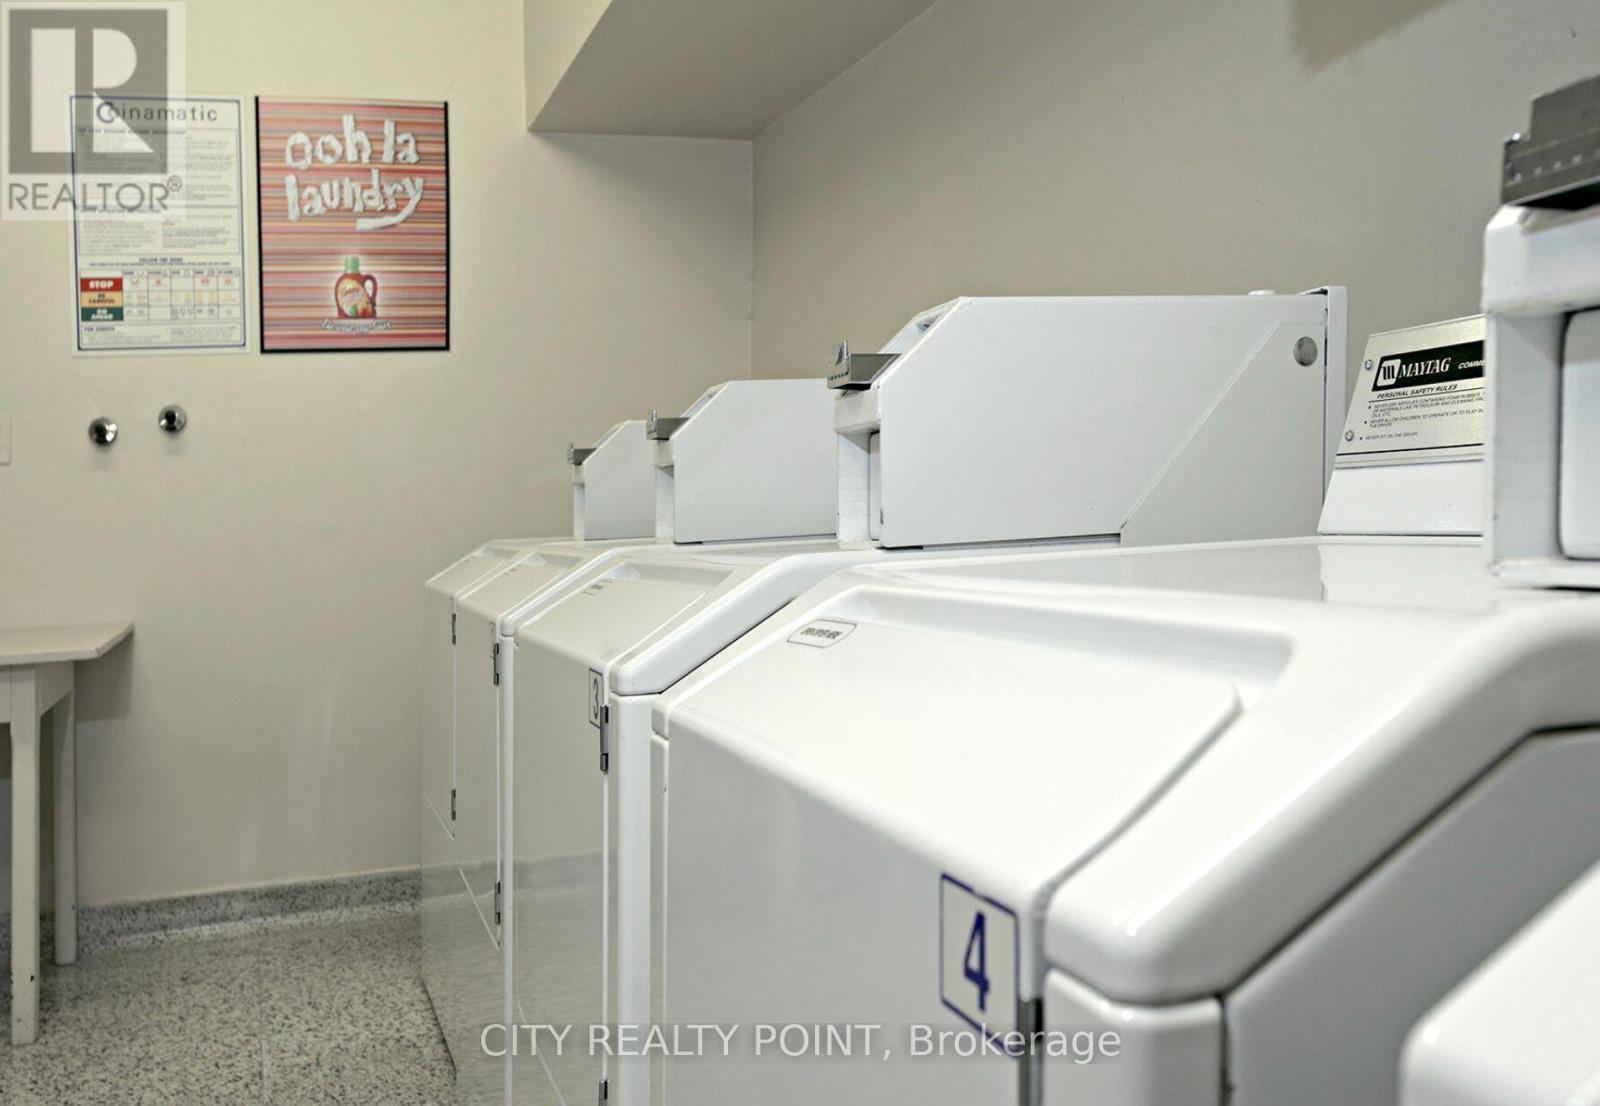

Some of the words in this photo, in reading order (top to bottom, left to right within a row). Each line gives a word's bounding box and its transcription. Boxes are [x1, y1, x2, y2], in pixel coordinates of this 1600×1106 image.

[96, 101, 218, 123] Coinamatic
[381, 118, 420, 164] la
[285, 168, 424, 231] laundry
[89, 280, 114, 289] STOP
[1398, 357, 1452, 378] MAYTAG
[1377, 389, 1409, 399] PERSONAL
[1410, 387, 1434, 396] SAFETY
[1436, 384, 1458, 392] RULES
[593, 677, 599, 720] 3
[964, 911, 989, 1014] 4
